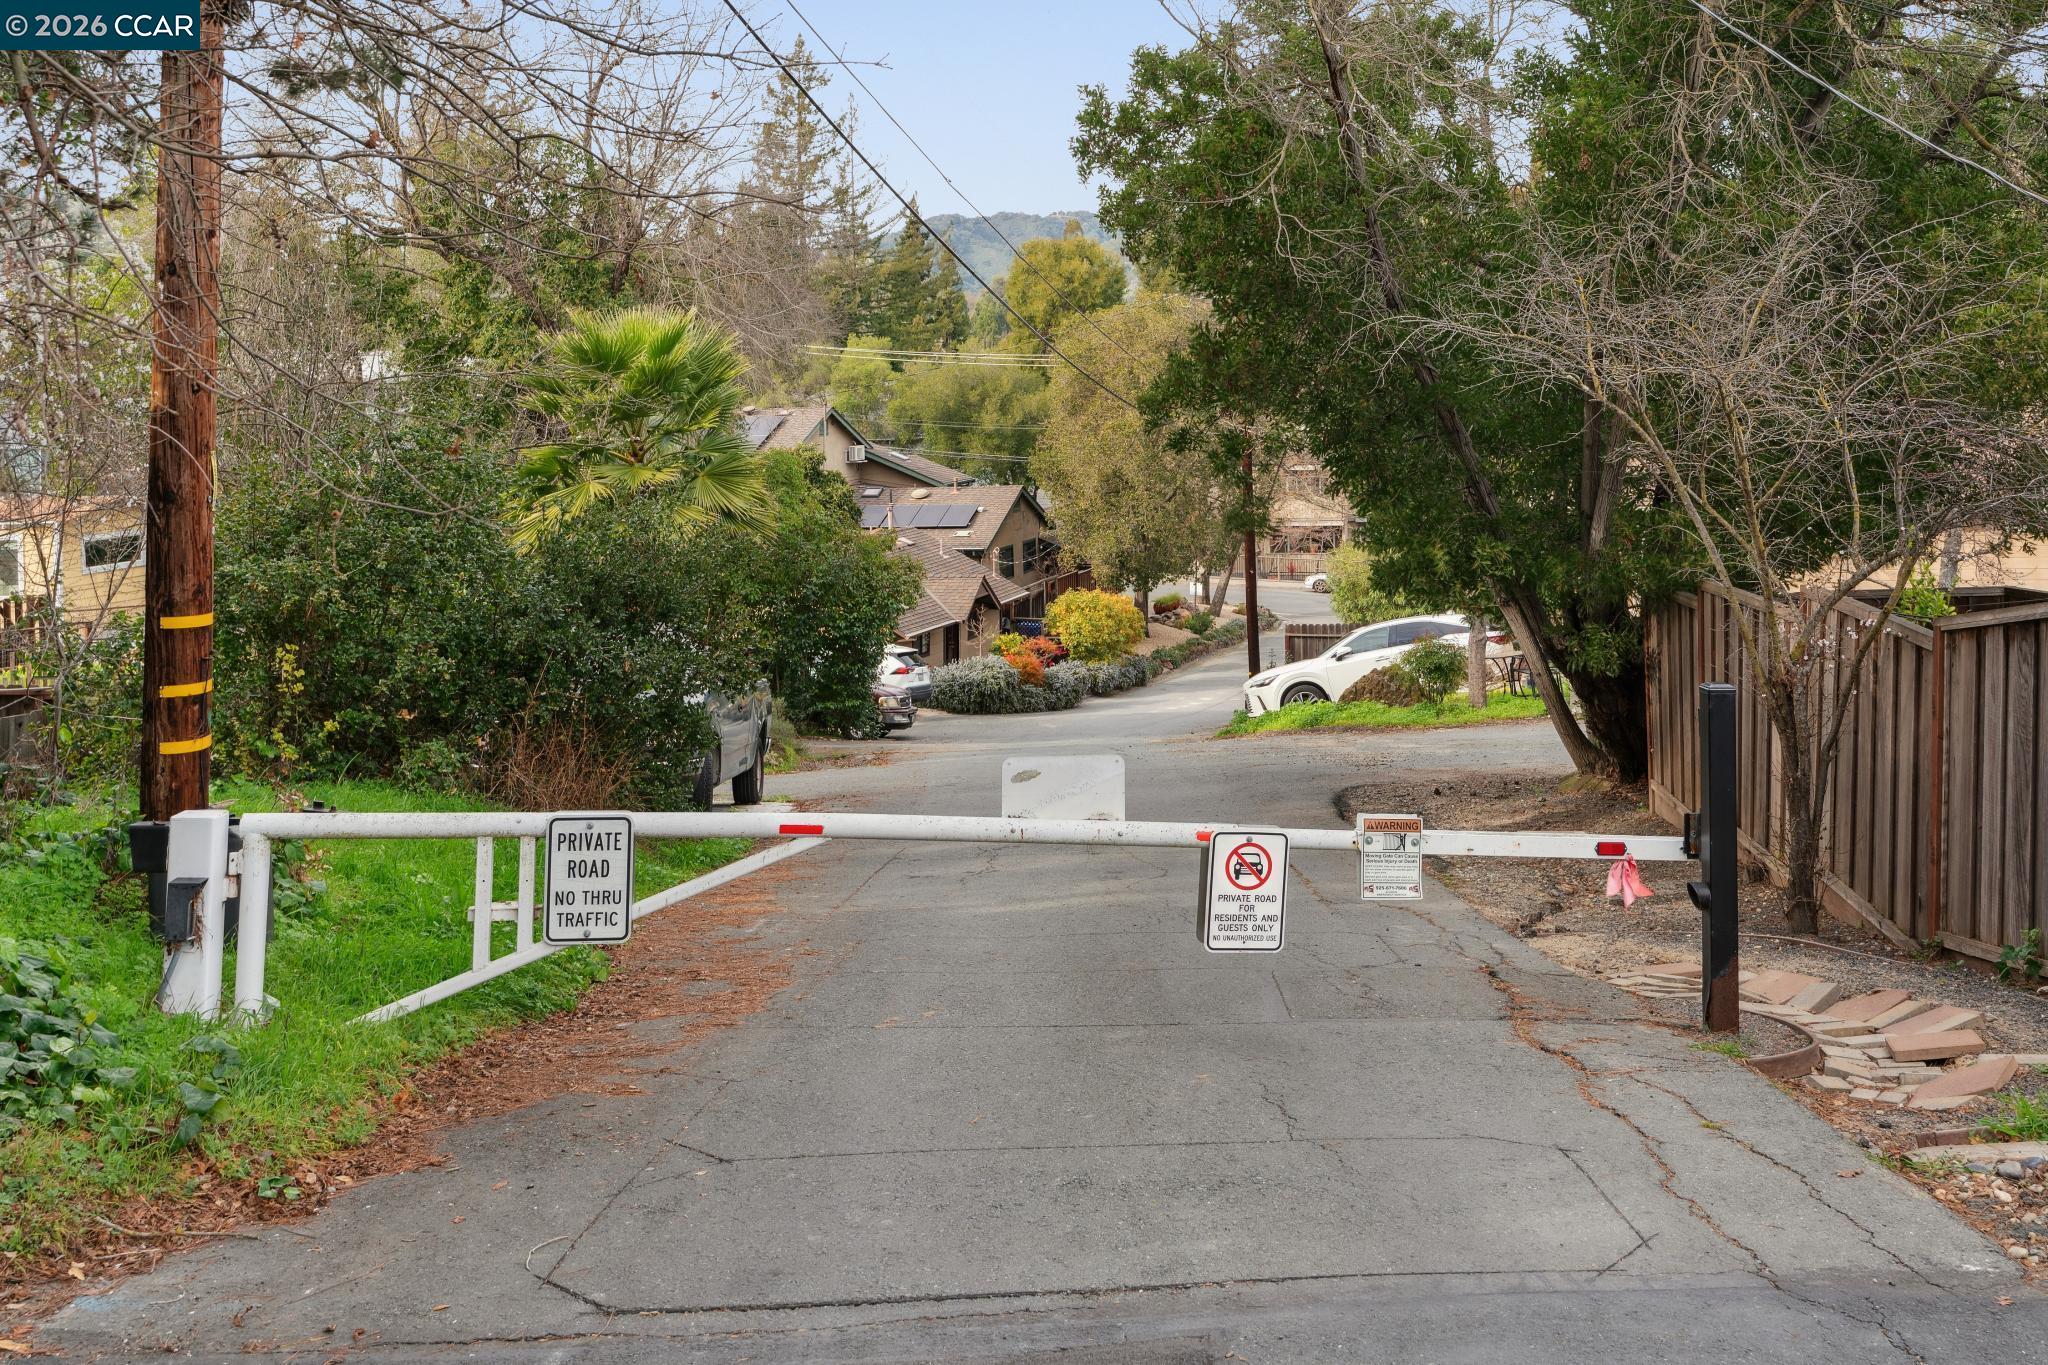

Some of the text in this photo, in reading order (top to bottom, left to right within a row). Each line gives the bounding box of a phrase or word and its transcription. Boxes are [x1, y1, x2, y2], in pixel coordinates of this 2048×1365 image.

[1374, 821, 1419, 831] WARNING
[557, 832, 622, 851] PRIVATE
[567, 859, 610, 878] ROAD
[555, 890, 622, 906] NO THRU
[1254, 894, 1277, 902] ROAD
[556, 911, 619, 927] TRAFFIC
[1214, 914, 1279, 922] RESIDENTS AND
[1217, 924, 1274, 932] GUESTS ONLY
